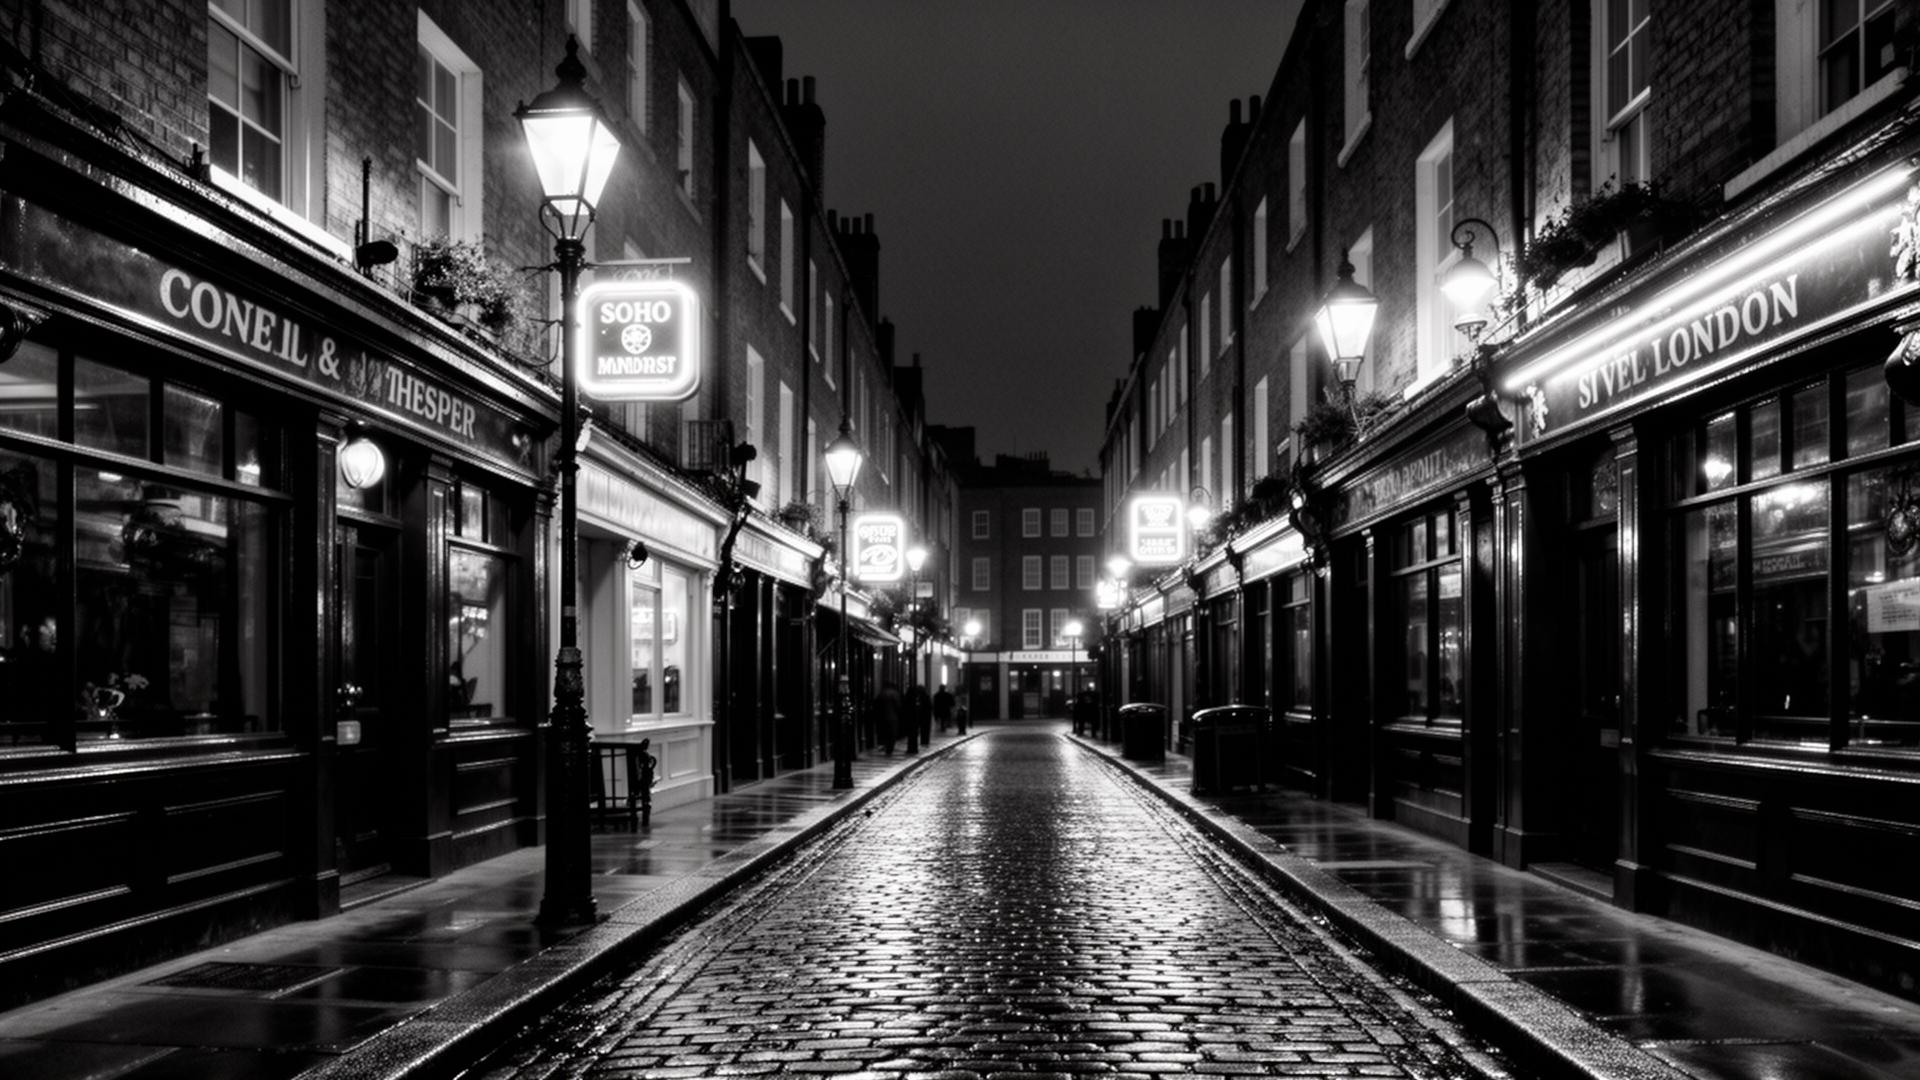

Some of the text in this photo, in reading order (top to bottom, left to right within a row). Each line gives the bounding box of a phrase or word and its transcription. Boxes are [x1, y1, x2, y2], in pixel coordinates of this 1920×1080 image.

[600, 300, 671, 324] SOHO
[1650, 273, 1801, 378] LONDON
[318, 336, 342, 382] &
[385, 365, 477, 440] THESPER
